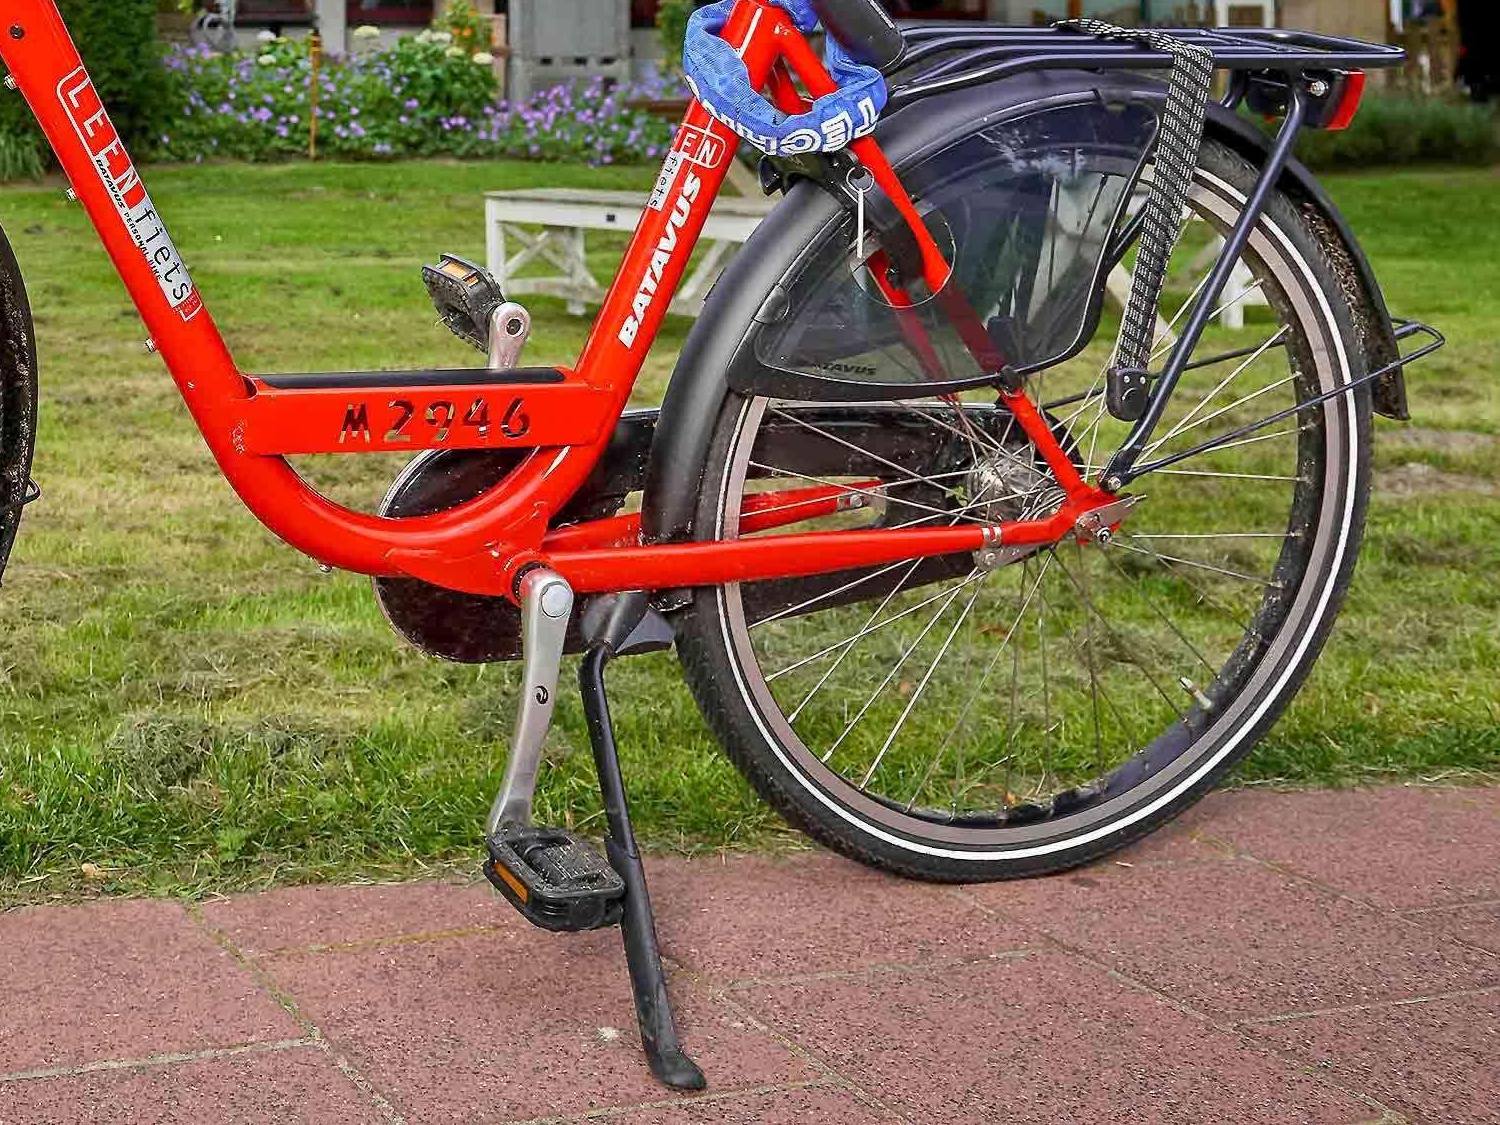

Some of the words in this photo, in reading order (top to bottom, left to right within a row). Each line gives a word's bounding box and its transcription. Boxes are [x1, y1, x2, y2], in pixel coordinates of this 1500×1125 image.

[67, 76, 140, 196] LEEN
[135, 207, 190, 301] fiets
[96, 159, 126, 209] BATAVUS
[650, 155, 678, 207] fiets
[618, 171, 702, 349] BATAVUS
[339, 402, 371, 444] M
[384, 396, 531, 443] 2946
